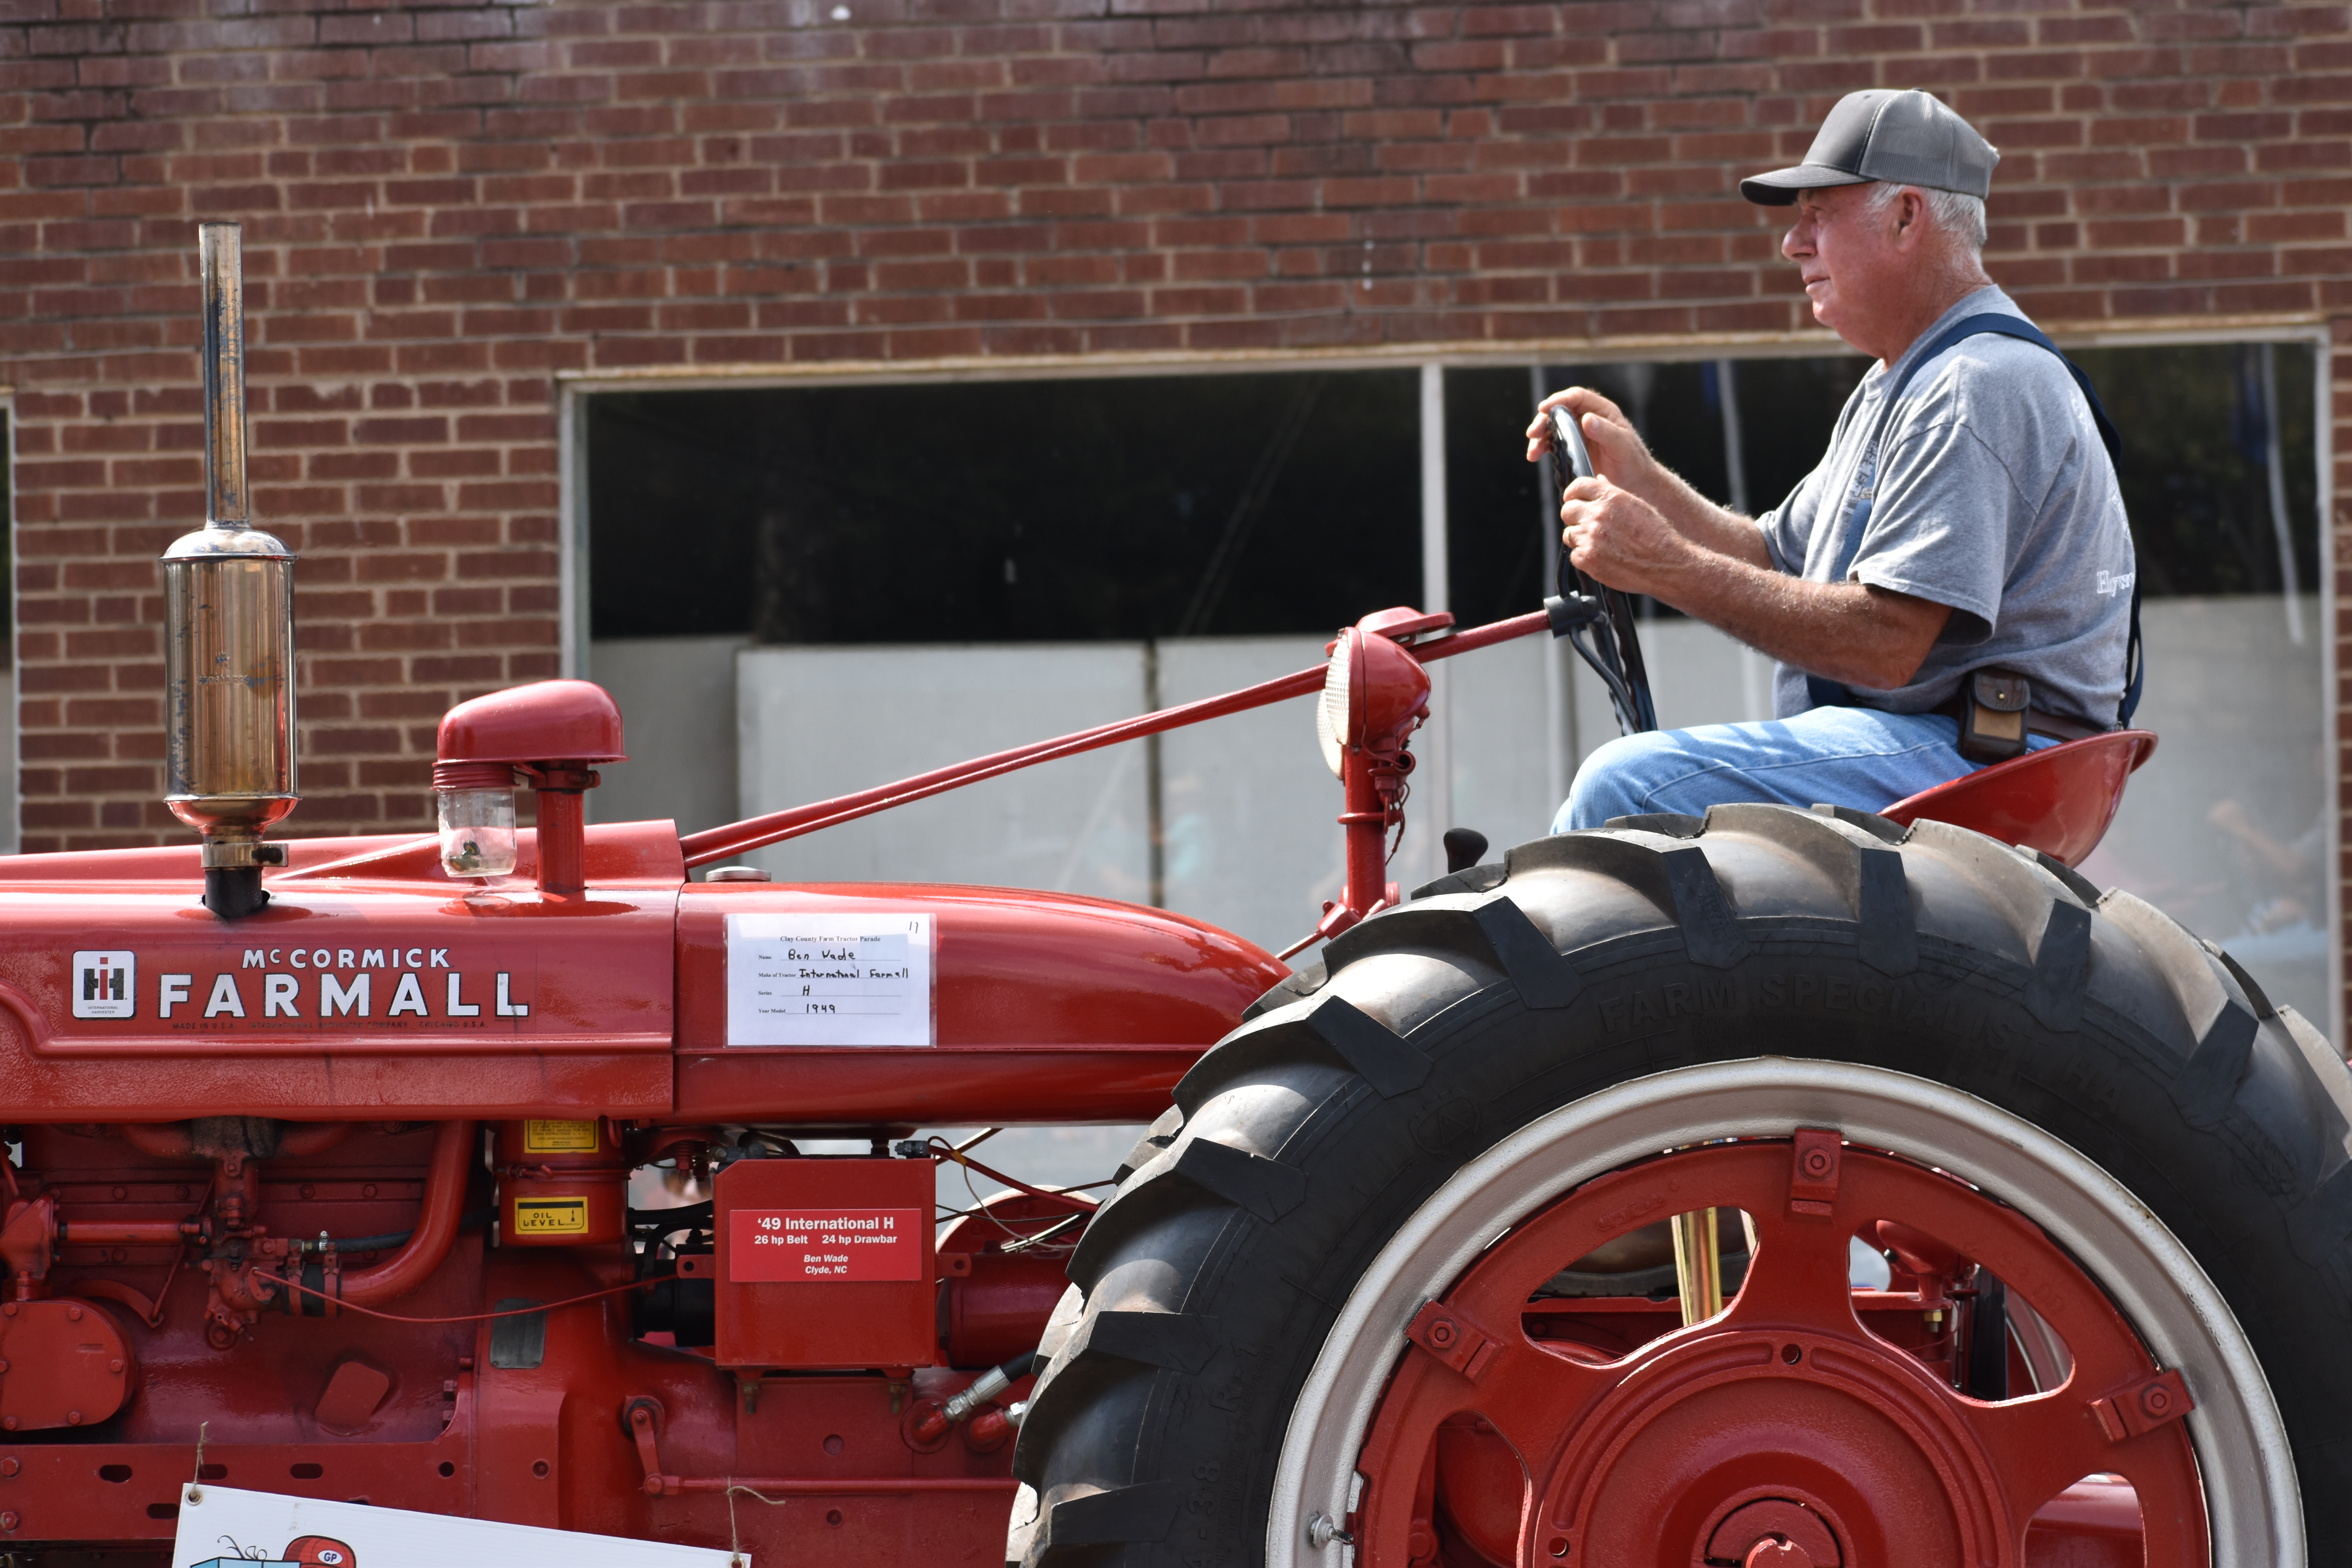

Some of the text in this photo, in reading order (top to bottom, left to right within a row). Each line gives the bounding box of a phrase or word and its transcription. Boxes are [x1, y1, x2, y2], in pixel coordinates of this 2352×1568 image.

[788, 949, 809, 960] Ben
[159, 973, 530, 1018] FARMALL
[802, 985, 810, 996] H
[807, 1004, 835, 1013] 1949
[786, 1217, 879, 1229] International
[884, 1217, 894, 1229] H
[755, 1234, 897, 1245] 26 hp Belt 24 hp Drawbar
[805, 1265, 848, 1275] Clyde, NC
[324, 1552, 338, 1563] GP
